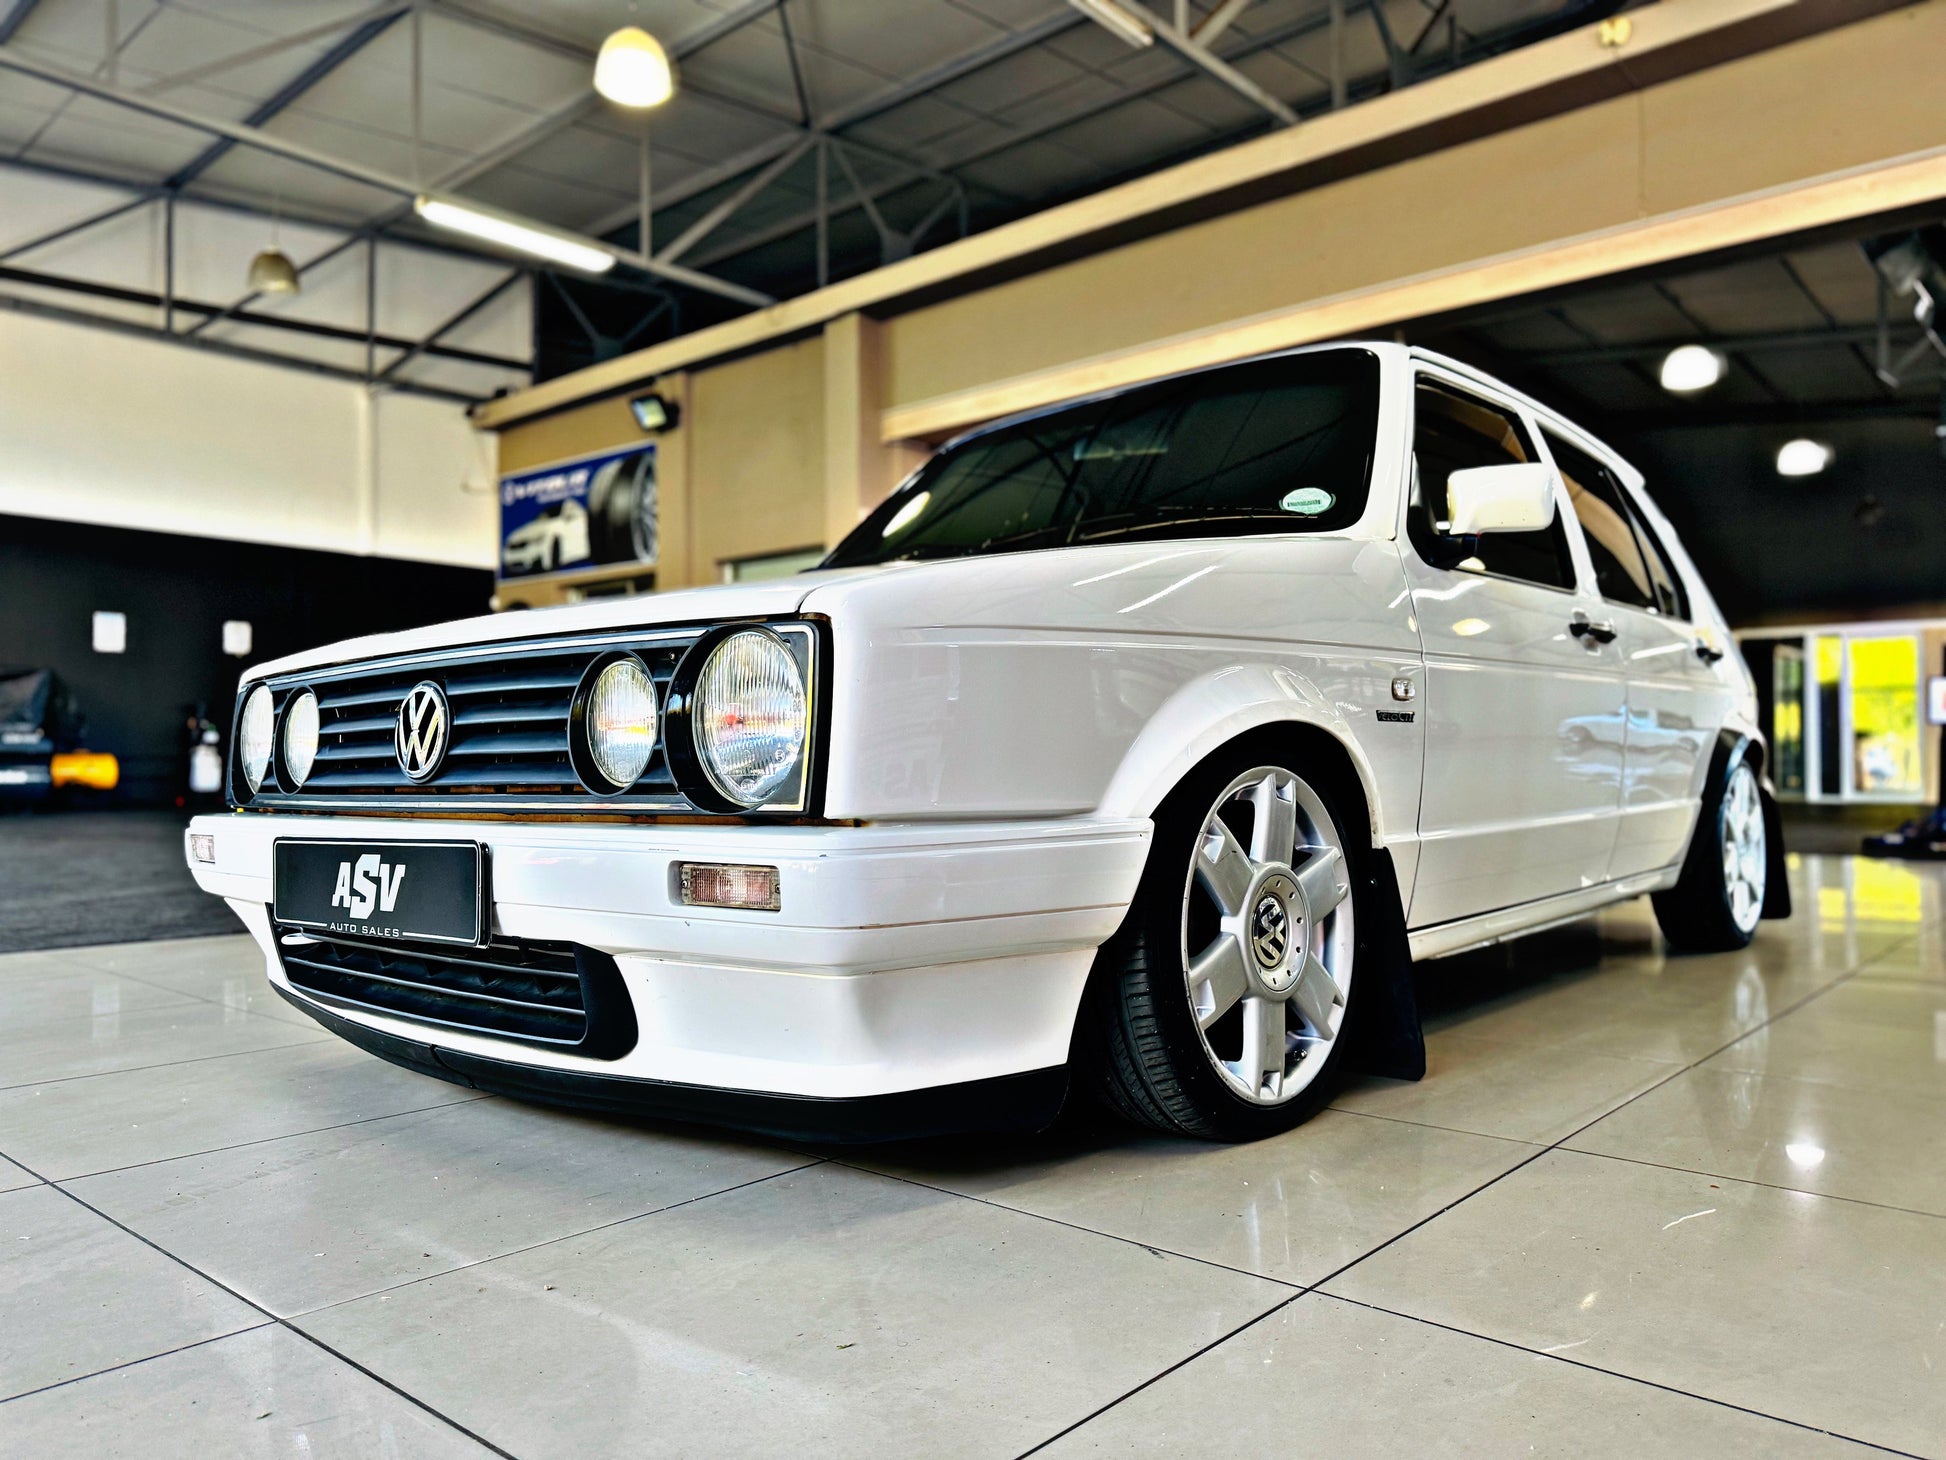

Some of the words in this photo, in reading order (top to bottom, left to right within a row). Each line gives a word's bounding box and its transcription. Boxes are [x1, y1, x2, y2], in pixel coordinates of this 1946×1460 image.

[399, 684, 446, 780] VW
[331, 853, 406, 920] ASV
[329, 922, 357, 933] AUTO
[361, 925, 400, 938] SALES
